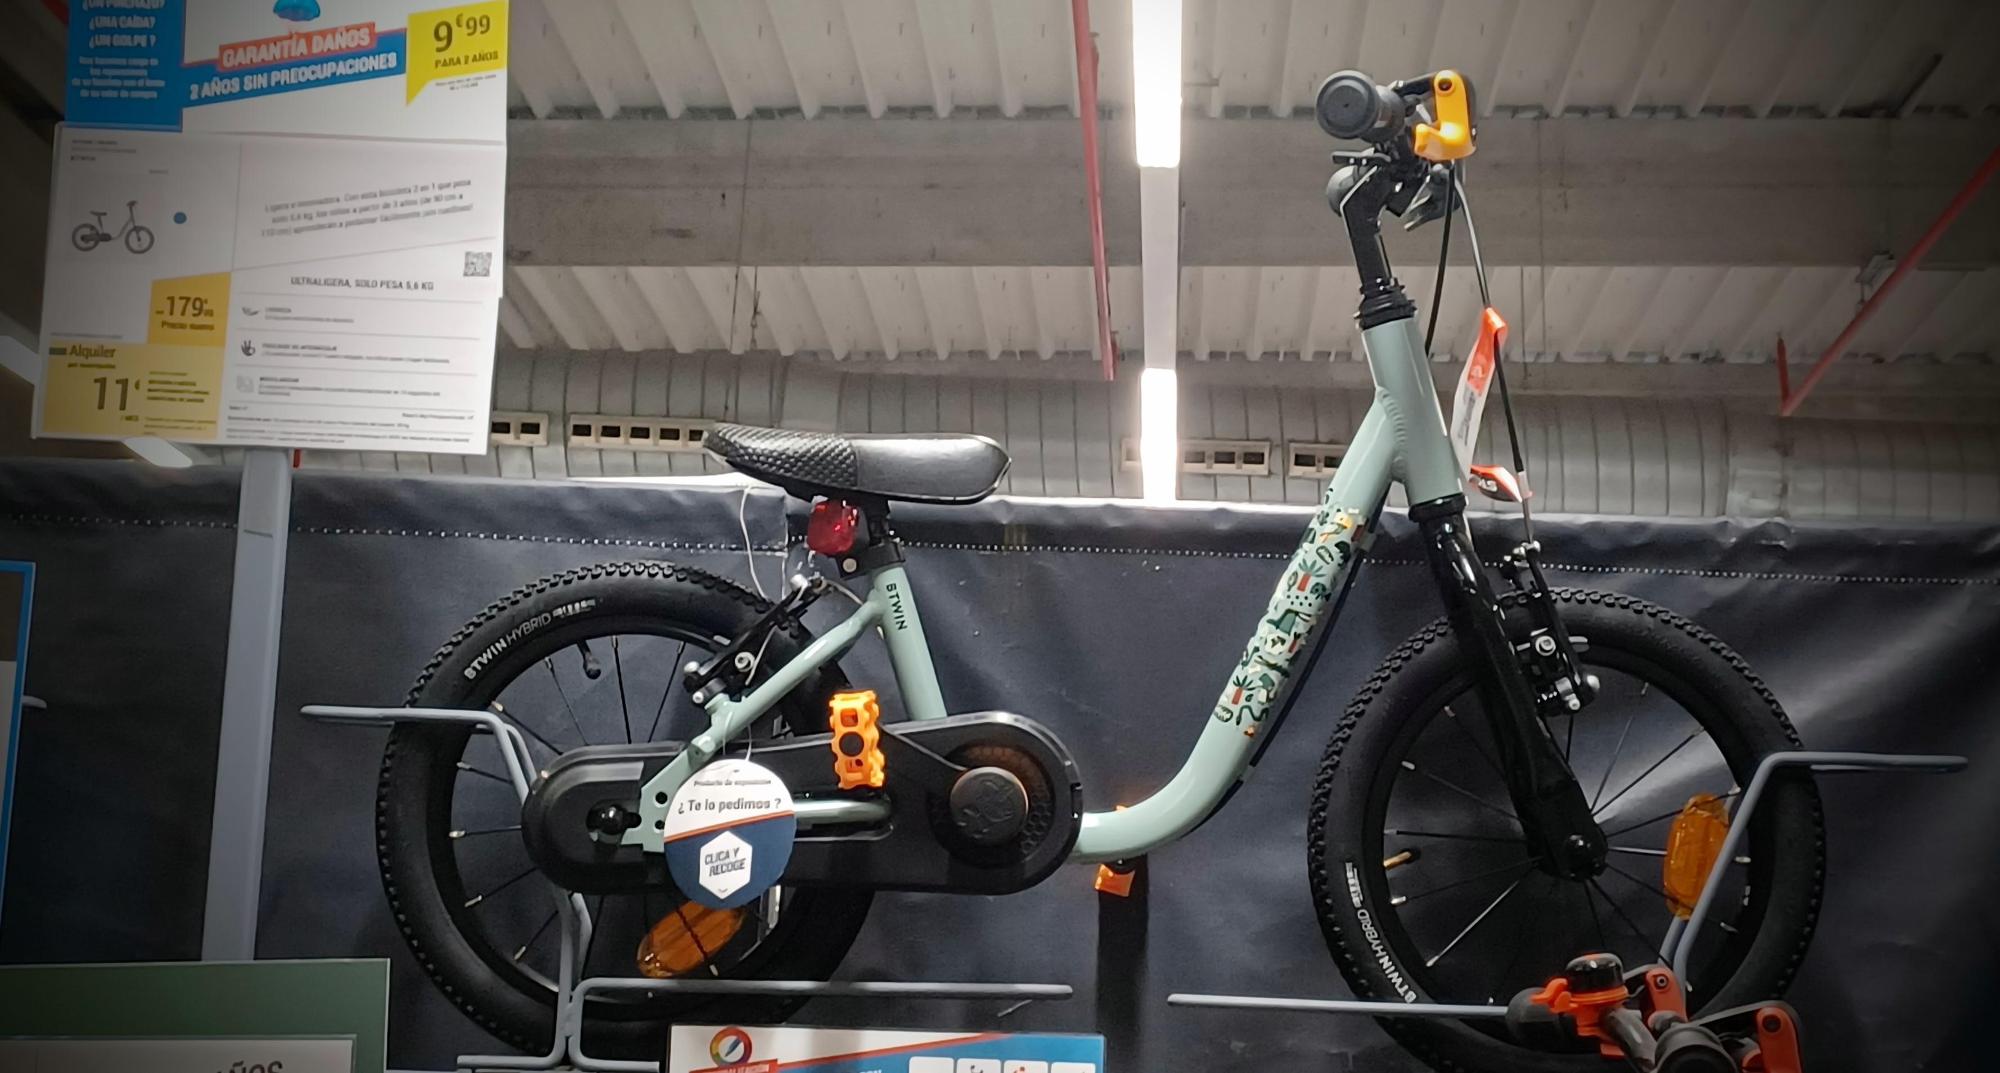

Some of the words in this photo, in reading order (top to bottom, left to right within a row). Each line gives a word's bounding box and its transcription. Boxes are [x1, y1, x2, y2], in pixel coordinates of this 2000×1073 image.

[222, 35, 308, 68] GARANTÍA
[311, 26, 371, 54] DAÑOS
[189, 84, 199, 101] 2
[200, 77, 241, 99] AÑOS
[243, 74, 269, 92] SIN
[270, 52, 398, 88] PREOCUPACIONES
[69, 344, 117, 360] Alquiler
[886, 582, 908, 631] BTWIN
[505, 612, 552, 647] HYBRID
[687, 799, 701, 812] Te
[704, 798, 716, 811] lo
[718, 798, 771, 814] pedimos
[704, 848, 730, 866] CLICA
[732, 847, 740, 858] Y
[708, 858, 747, 877] RECOGE
[1356, 908, 1387, 957] HYBRID
